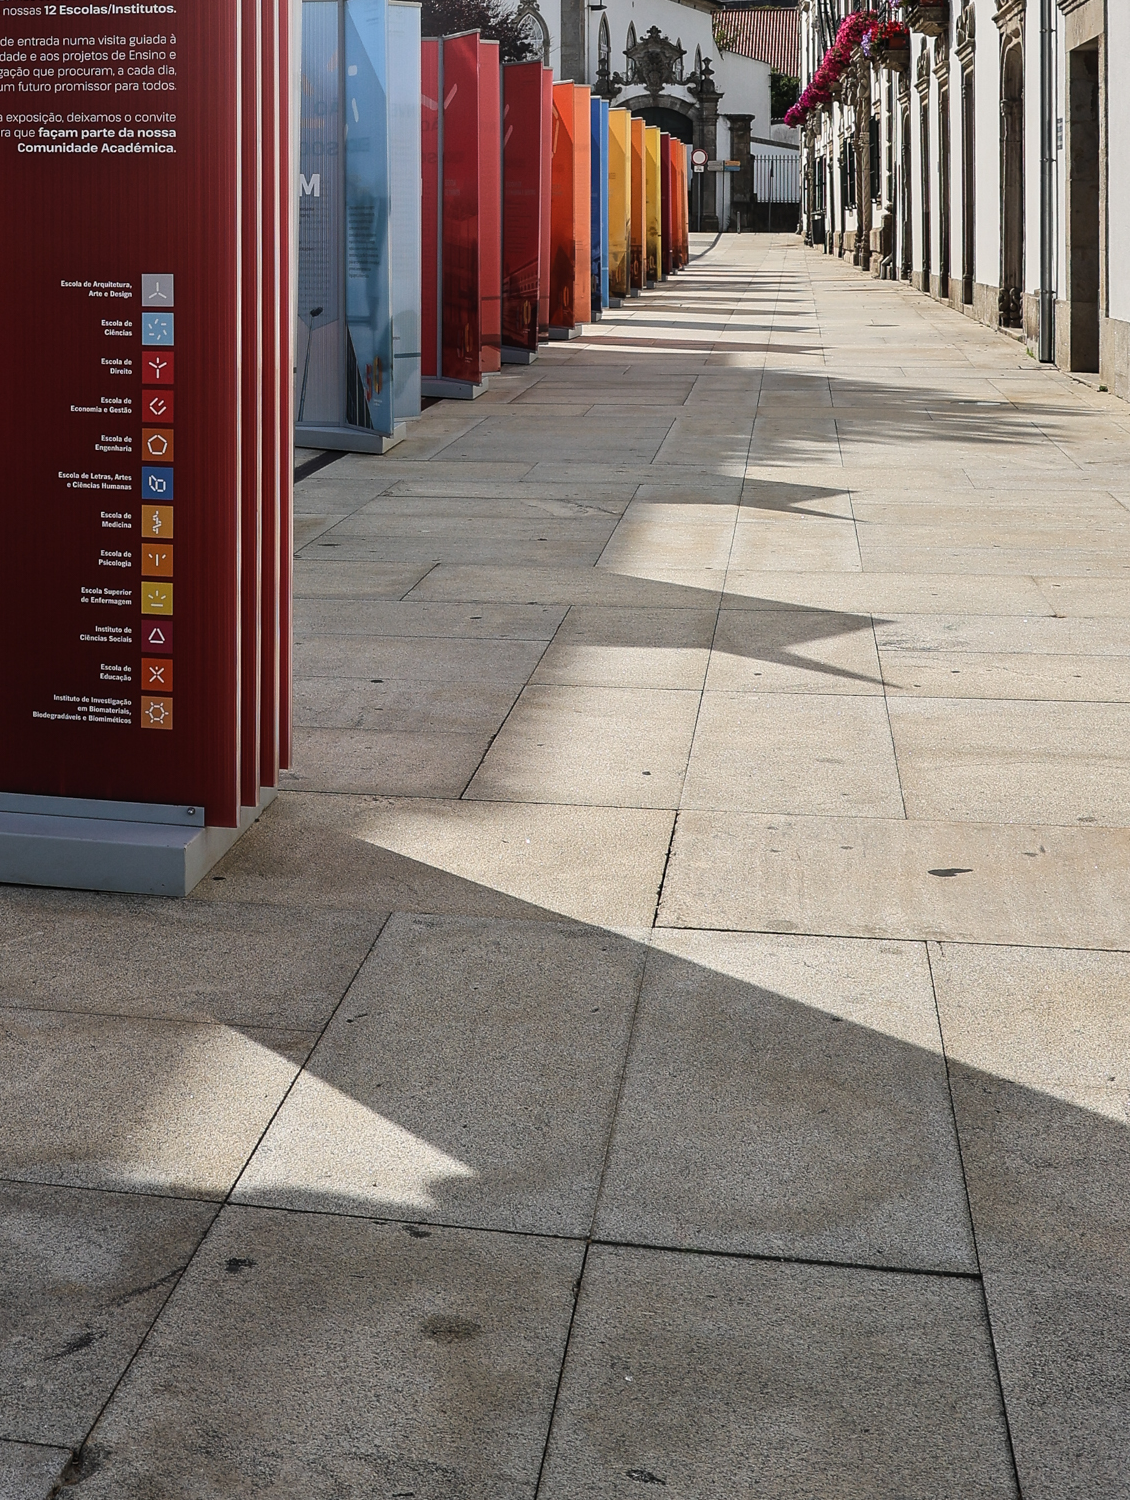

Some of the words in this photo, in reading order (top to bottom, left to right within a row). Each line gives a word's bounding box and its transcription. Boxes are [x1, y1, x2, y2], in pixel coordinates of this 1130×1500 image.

[2, 7, 42, 16] nossas
[43, 5, 57, 15] 12
[59, 3, 177, 15] Escolas/Institutos.
[17, 81, 52, 92] futuro
[54, 81, 113, 94] promissor
[114, 82, 140, 93] para
[141, 80, 177, 91] todos.
[6, 112, 64, 125] exposição,
[66, 112, 122, 123] deixamos
[124, 114, 132, 123] o
[134, 111, 177, 123] convite
[13, 129, 36, 140] que
[38, 126, 79, 140] façam
[81, 128, 116, 140] parte
[118, 127, 135, 138] da
[137, 129, 177, 138] nossa
[17, 142, 99, 153] Comunidade
[100, 142, 177, 153] Académica.
[83, 280, 92, 288] de
[92, 280, 133, 289] Arquitetura,
[109, 290, 133, 299] Design
[101, 319, 123, 327] Escola
[104, 328, 133, 337] Ciências
[101, 357, 123, 365] Escola
[109, 367, 133, 375] Direito
[100, 396, 123, 404] Escola
[123, 397, 132, 405] de
[70, 405, 103, 413] Economia
[108, 406, 133, 414] Gestão
[101, 434, 123, 442] Escola
[94, 443, 133, 453] Engenharia
[57, 471, 80, 479] Escola
[80, 472, 90, 480] de
[90, 472, 114, 481] Letras,
[114, 473, 132, 481] Artes
[72, 481, 101, 489] Ciências
[101, 482, 132, 490] Humanas
[100, 511, 123, 519] Escola
[123, 512, 132, 520] de
[101, 520, 132, 529] Medicina
[100, 549, 122, 557] Escola
[123, 550, 132, 558] de
[98, 558, 132, 568] Psicologia
[80, 586, 103, 595] Escola
[103, 587, 132, 596] Superior
[90, 596, 132, 606] Enfermagem
[95, 625, 123, 633] Instituto
[123, 626, 133, 634] de
[79, 633, 108, 642] Ciências
[108, 635, 133, 643] Sociais
[100, 663, 122, 672] Escola
[99, 672, 132, 682] Educação
[53, 694, 81, 702] Instituto
[90, 696, 132, 706] Investigação
[88, 705, 132, 716] Biomateriais,
[32, 710, 82, 721] Biodegradáveis
[88, 714, 132, 724] Biomiméticos
